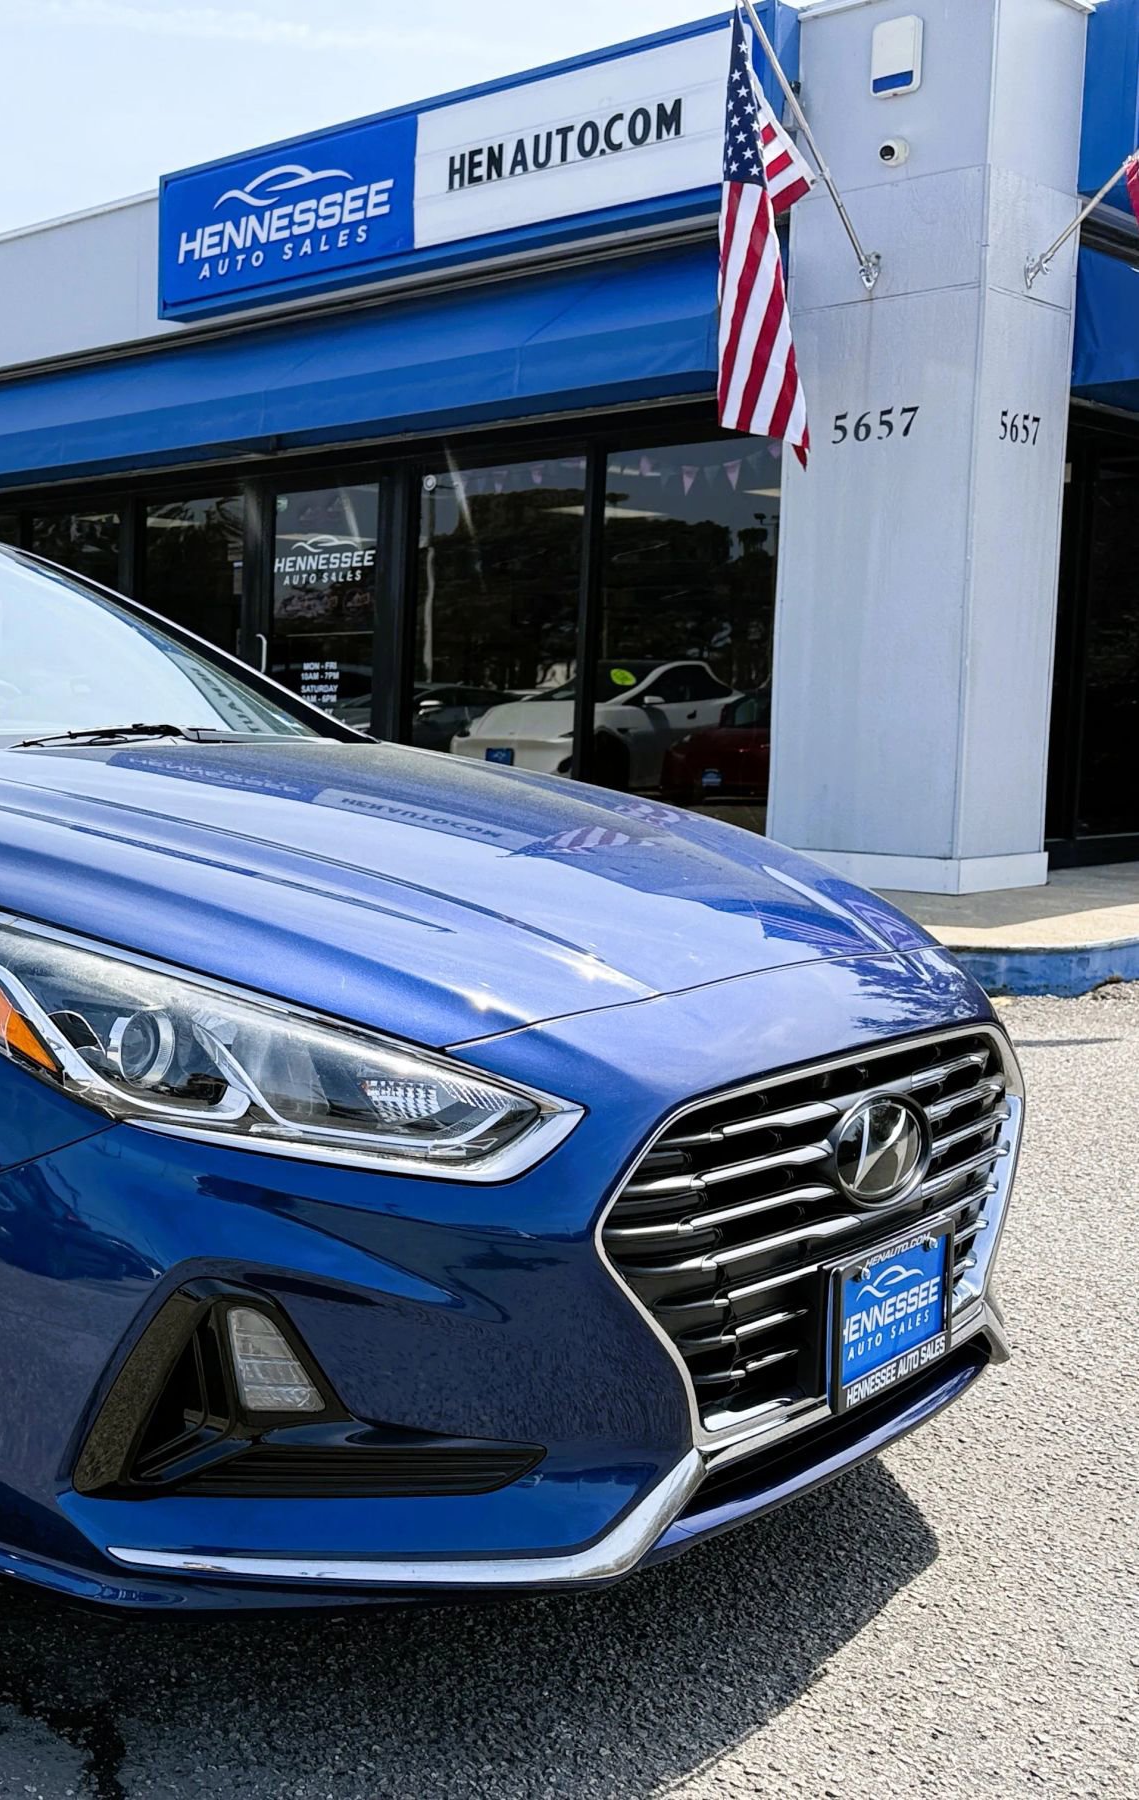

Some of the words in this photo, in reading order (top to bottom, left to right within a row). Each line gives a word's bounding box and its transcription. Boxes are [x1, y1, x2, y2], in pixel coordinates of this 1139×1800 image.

[178, 178, 394, 264] HENNESSEE
[198, 251, 264, 280] AUTO
[282, 225, 368, 260] SALES
[831, 405, 920, 444] 5657
[999, 408, 1041, 446] 5657
[274, 550, 376, 573] HENNESSEE
[283, 573, 317, 586] AUTO
[322, 570, 362, 584] SALES
[303, 662, 321, 670] MON
[325, 661, 337, 670] FRI
[301, 684, 338, 693] SATURDAY
[865, 1231, 932, 1269] HENAUTO.COM
[847, 1332, 883, 1361] AUTO
[890, 1308, 930, 1339] SALES
[846, 1362, 897, 1408] HENNESSEE
[897, 1350, 919, 1379] AUTO
[920, 1335, 946, 1367] SALES
